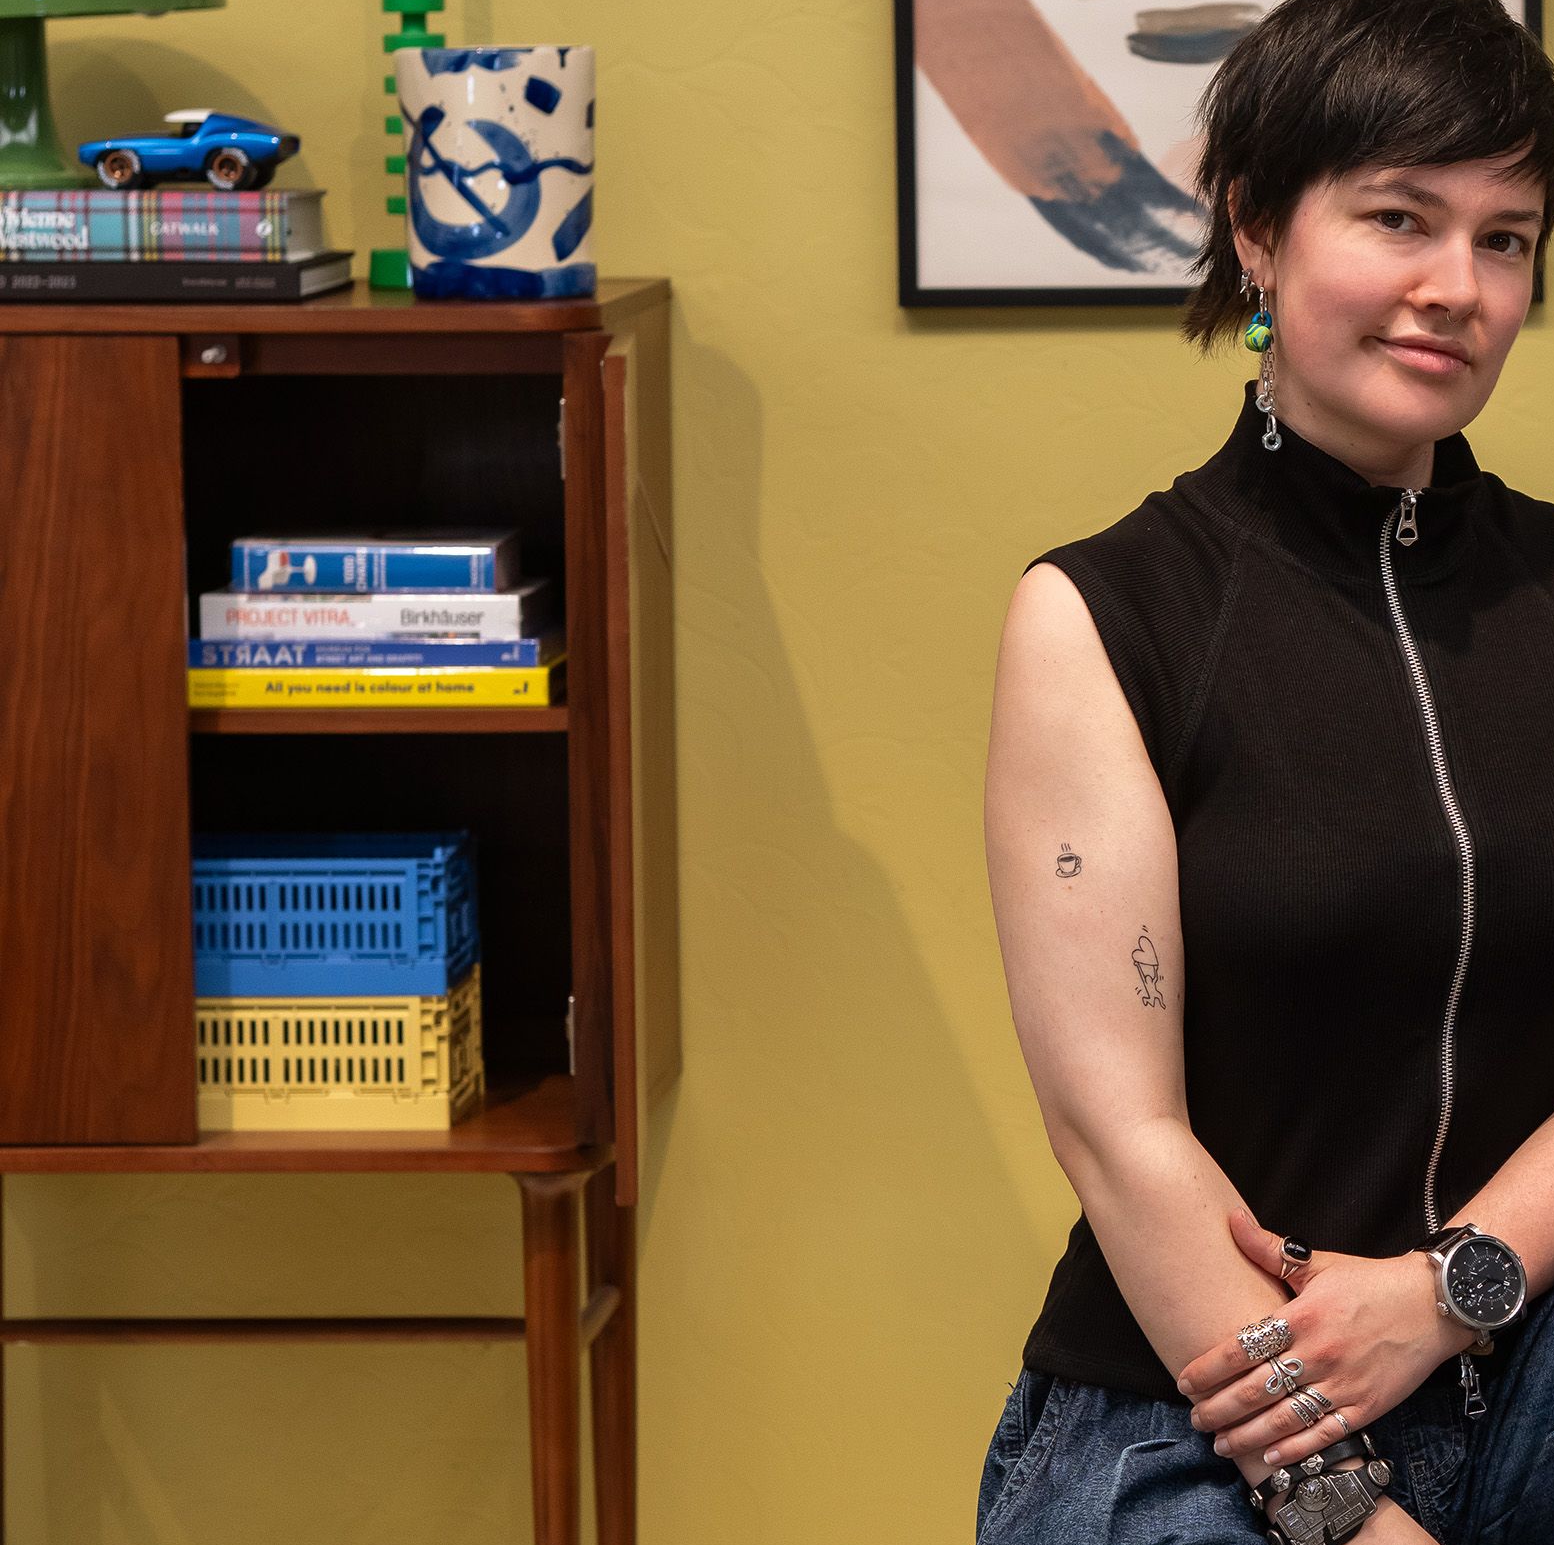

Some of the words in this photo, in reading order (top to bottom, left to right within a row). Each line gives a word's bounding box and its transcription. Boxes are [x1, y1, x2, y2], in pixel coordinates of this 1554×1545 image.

[0, 207, 76, 229] ivienne
[150, 221, 219, 236] CATWALK
[225, 607, 298, 627] PROJECT
[400, 607, 485, 626] Birkhäuser
[265, 681, 283, 693] All
[288, 684, 311, 697] you
[316, 681, 350, 693] need
[355, 682, 365, 693] is
[370, 681, 412, 693] colour
[417, 681, 431, 693] at
[436, 681, 474, 693] home
